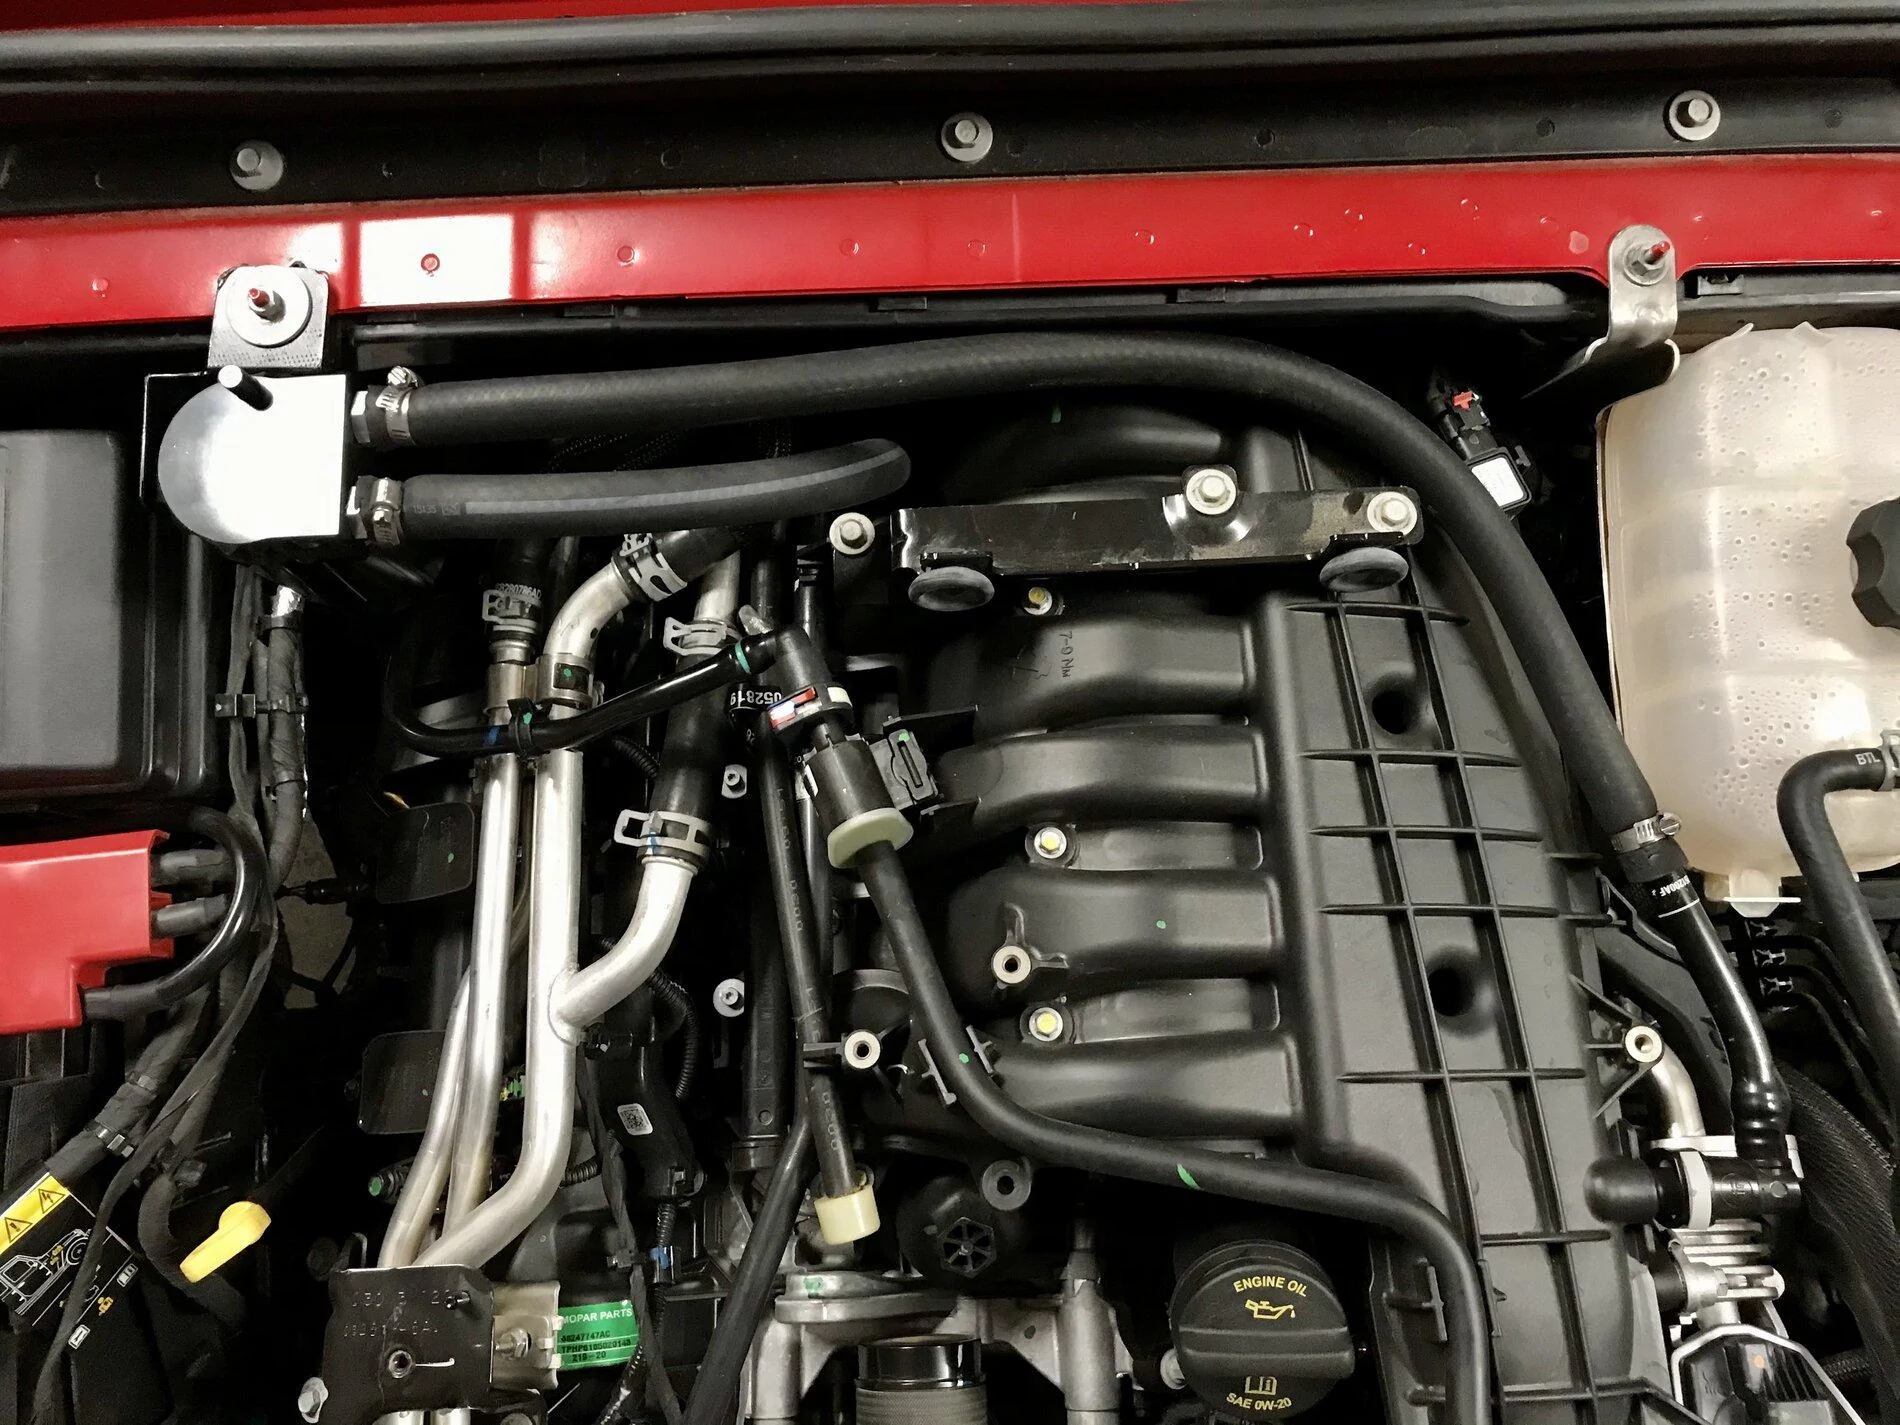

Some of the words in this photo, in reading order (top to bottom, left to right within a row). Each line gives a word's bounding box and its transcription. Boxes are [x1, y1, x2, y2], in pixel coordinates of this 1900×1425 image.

[1855, 751, 1881, 766] BTL
[1233, 1276, 1286, 1293] ENGINE
[1287, 1279, 1308, 1297] OIL
[599, 1307, 633, 1320] PARTS
[1226, 1393, 1251, 1409] SAE
[1254, 1397, 1292, 1411] 0W-20
